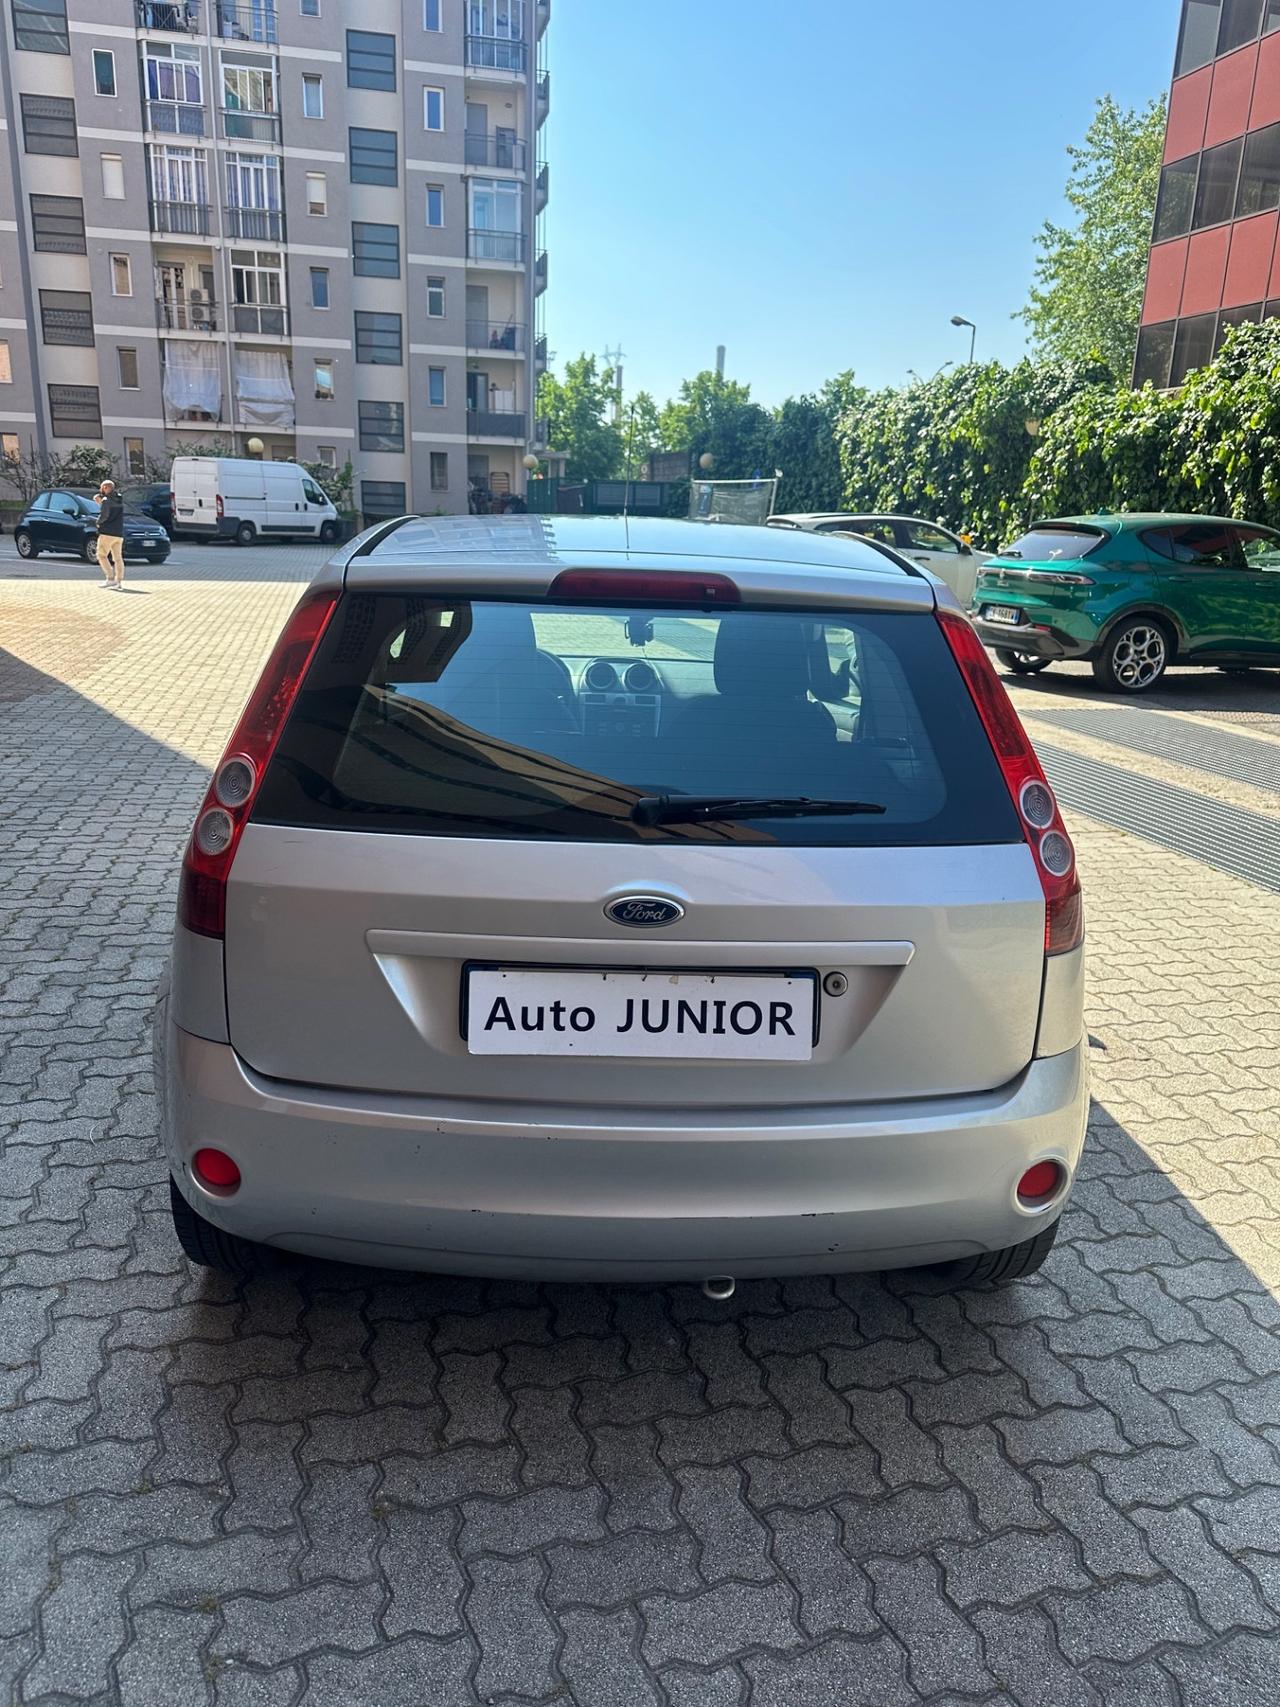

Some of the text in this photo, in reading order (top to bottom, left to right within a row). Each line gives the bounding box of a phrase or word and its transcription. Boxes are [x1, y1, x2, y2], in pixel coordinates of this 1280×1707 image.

[622, 901, 667, 920] Ford
[483, 996, 796, 1036] Auto JUNIOR
